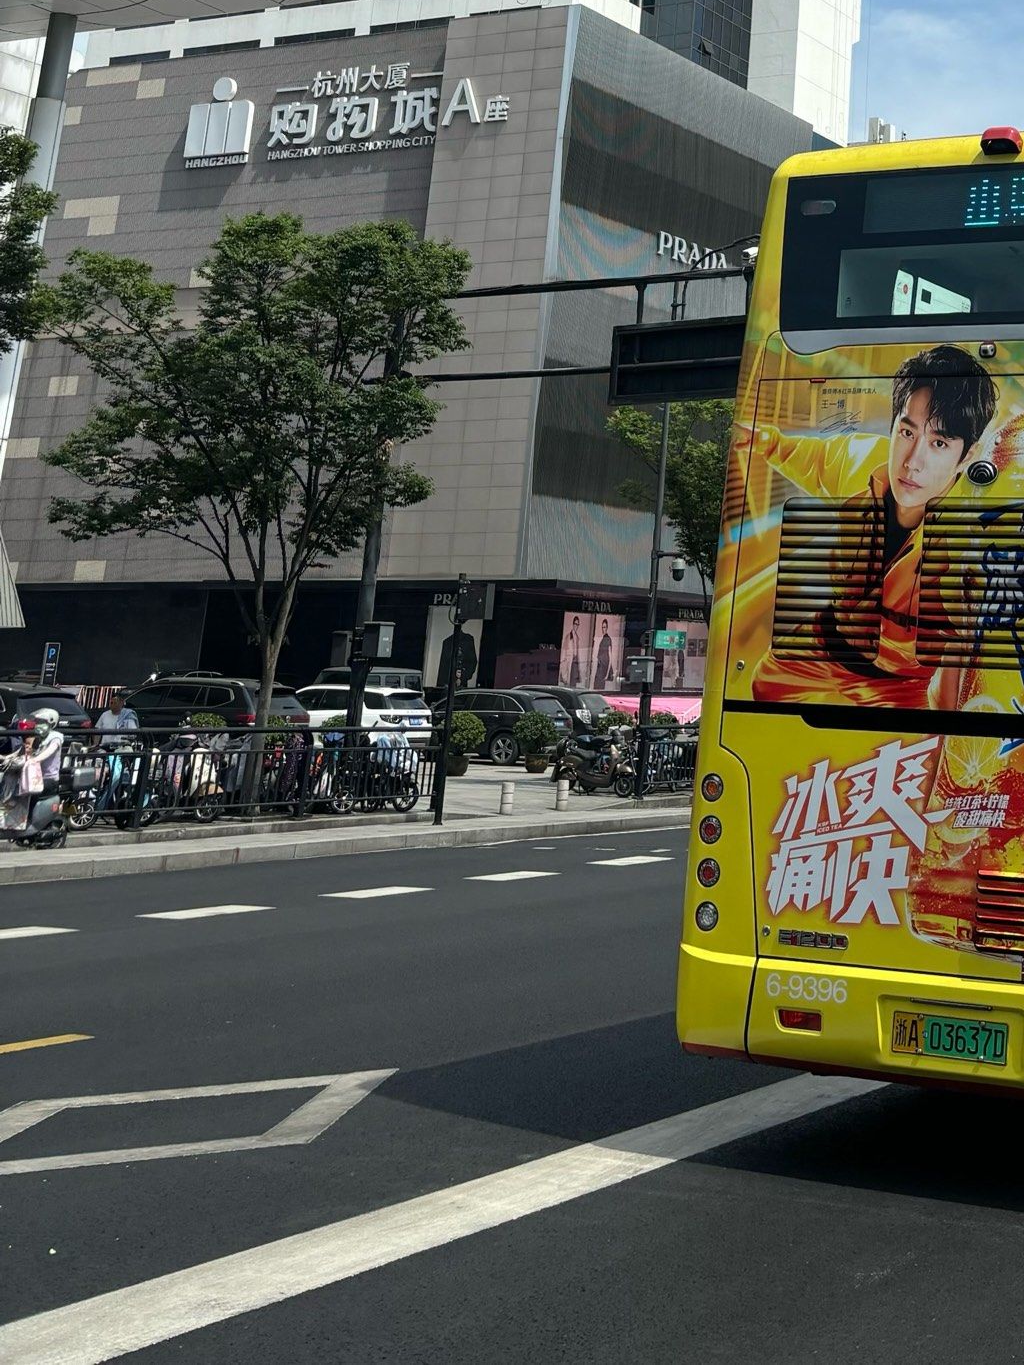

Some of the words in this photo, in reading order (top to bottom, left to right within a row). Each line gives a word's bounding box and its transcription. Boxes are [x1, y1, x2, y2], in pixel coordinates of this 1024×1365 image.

[311, 62, 410, 98] 杭州大厦
[267, 87, 439, 149] 购物城
[185, 154, 249, 169] HANGZHOU
[268, 145, 321, 161] HANGZHOU
[322, 142, 357, 156] TOWER
[358, 138, 410, 153] SHOPPING
[411, 135, 436, 148] CITY
[657, 231, 727, 269] PRADA
[433, 593, 457, 605] PRA
[582, 600, 612, 613] PRADA
[678, 608, 704, 620] PRADA
[772, 734, 956, 853] 冰爽
[767, 821, 909, 925] 痛快
[766, 972, 848, 1004] 6-9396
[929, 1022, 1006, 1058] 03637D
